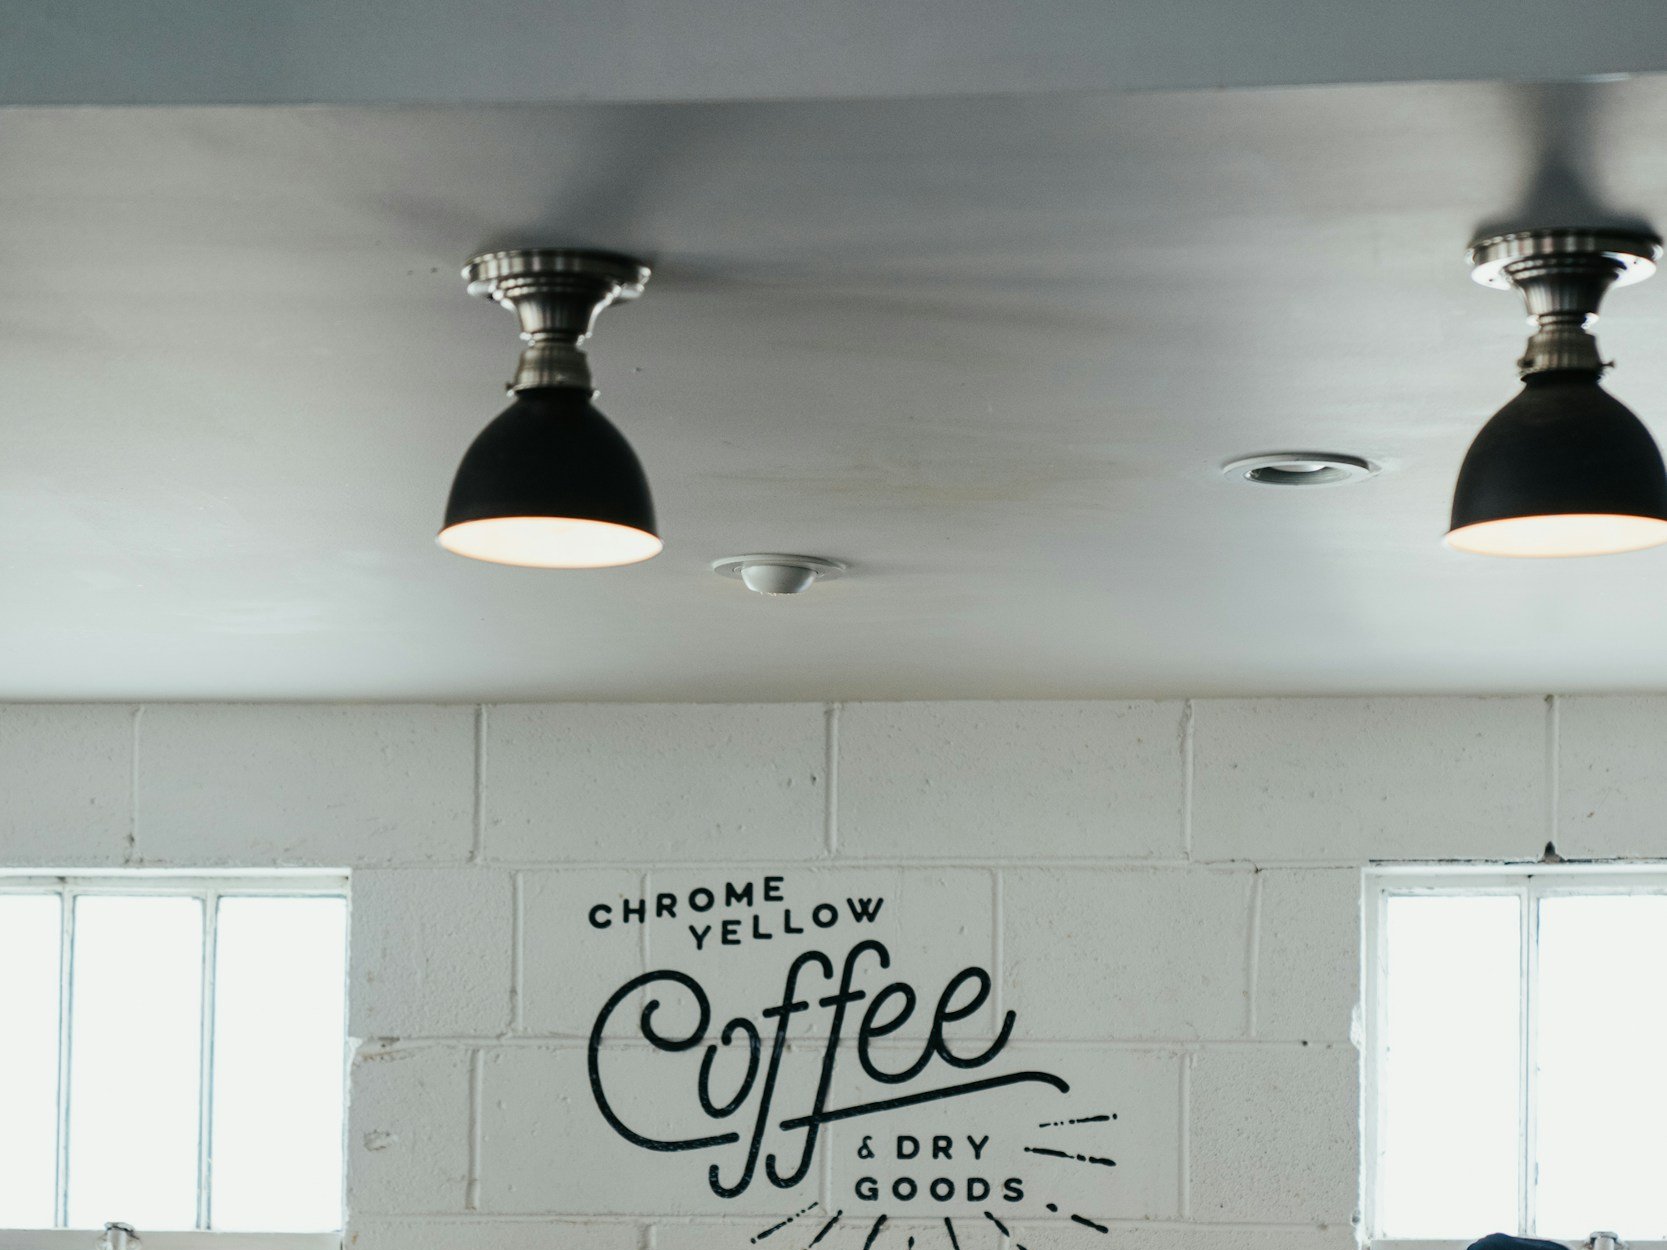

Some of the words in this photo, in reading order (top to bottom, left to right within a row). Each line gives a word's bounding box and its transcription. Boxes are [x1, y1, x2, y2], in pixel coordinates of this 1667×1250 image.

[588, 876, 784, 929] CHROME
[689, 897, 884, 950] YELLOW
[588, 940, 1070, 1198] Coffee
[857, 1135, 875, 1160] &
[896, 1135, 989, 1160] DRY
[854, 1177, 1024, 1201] GOODS
